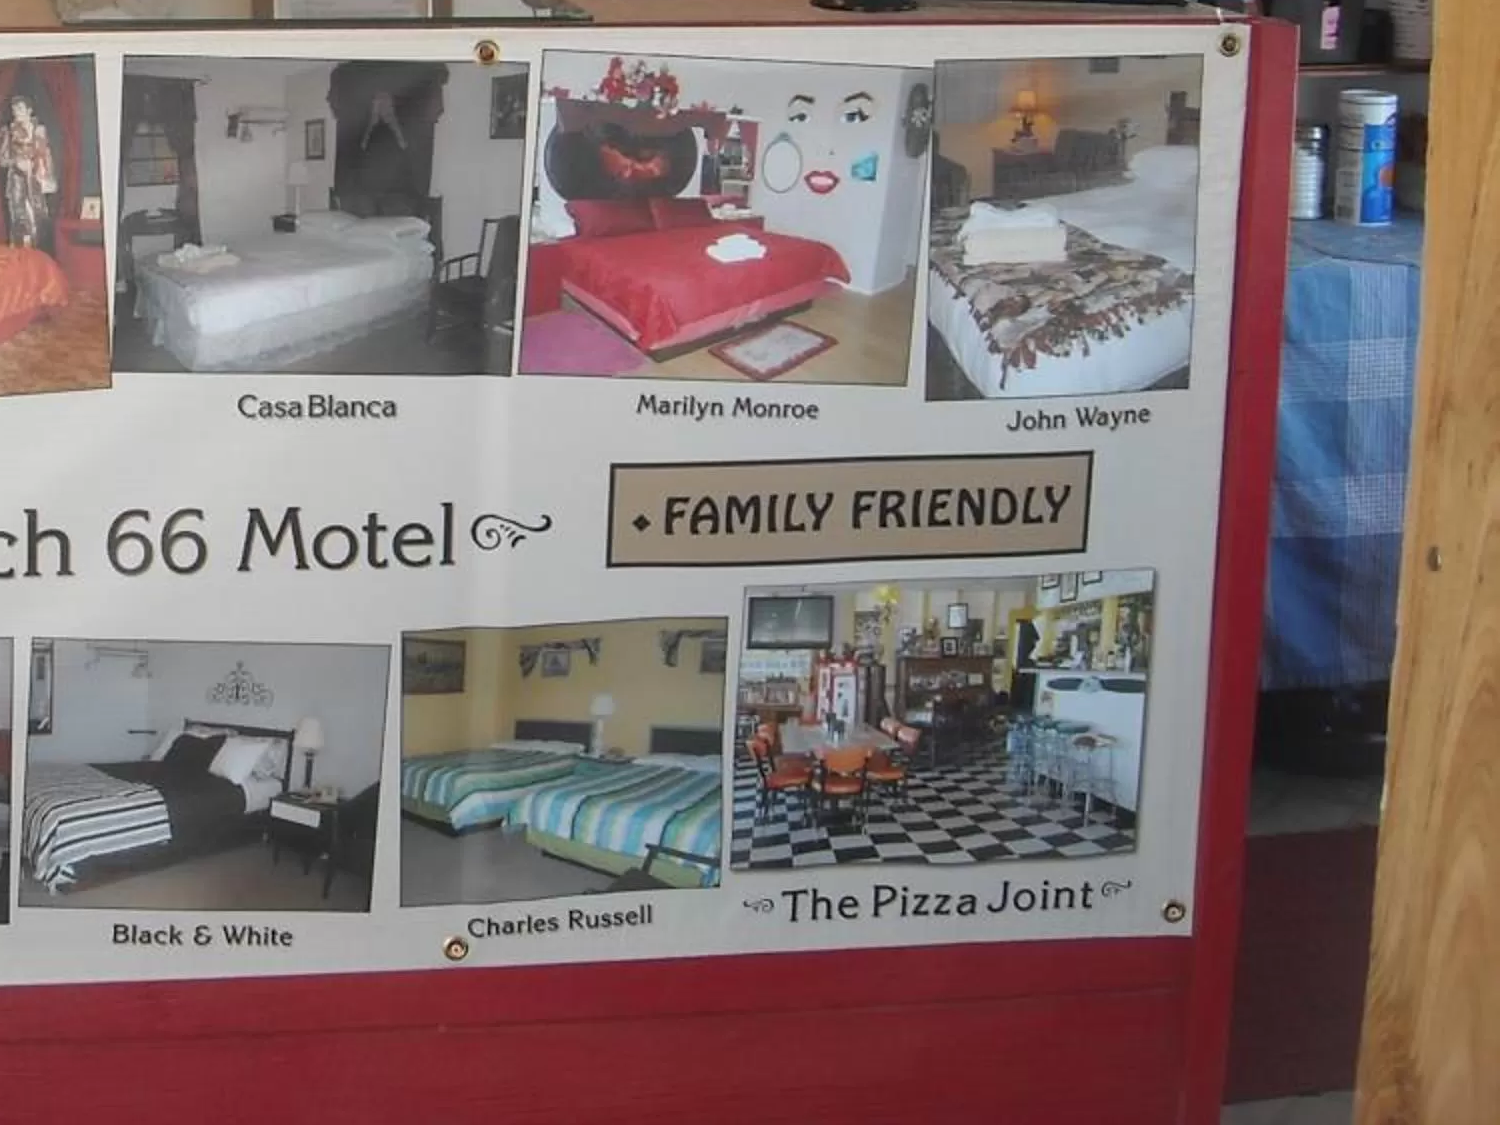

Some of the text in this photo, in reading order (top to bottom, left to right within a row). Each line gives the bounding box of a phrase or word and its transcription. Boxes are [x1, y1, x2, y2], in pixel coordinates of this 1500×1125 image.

[237, 394, 398, 420] Casa Blanca
[636, 394, 820, 423] Marilyn Monroe
[1006, 405, 1152, 434] John Wayne
[663, 483, 1073, 537] FAMILY FRIENDLY
[106, 507, 207, 577] 66
[237, 502, 457, 575] Motel
[781, 878, 1094, 924] The Pizza Joint
[111, 922, 294, 948] Black & White
[467, 905, 654, 940] Charles Russell
